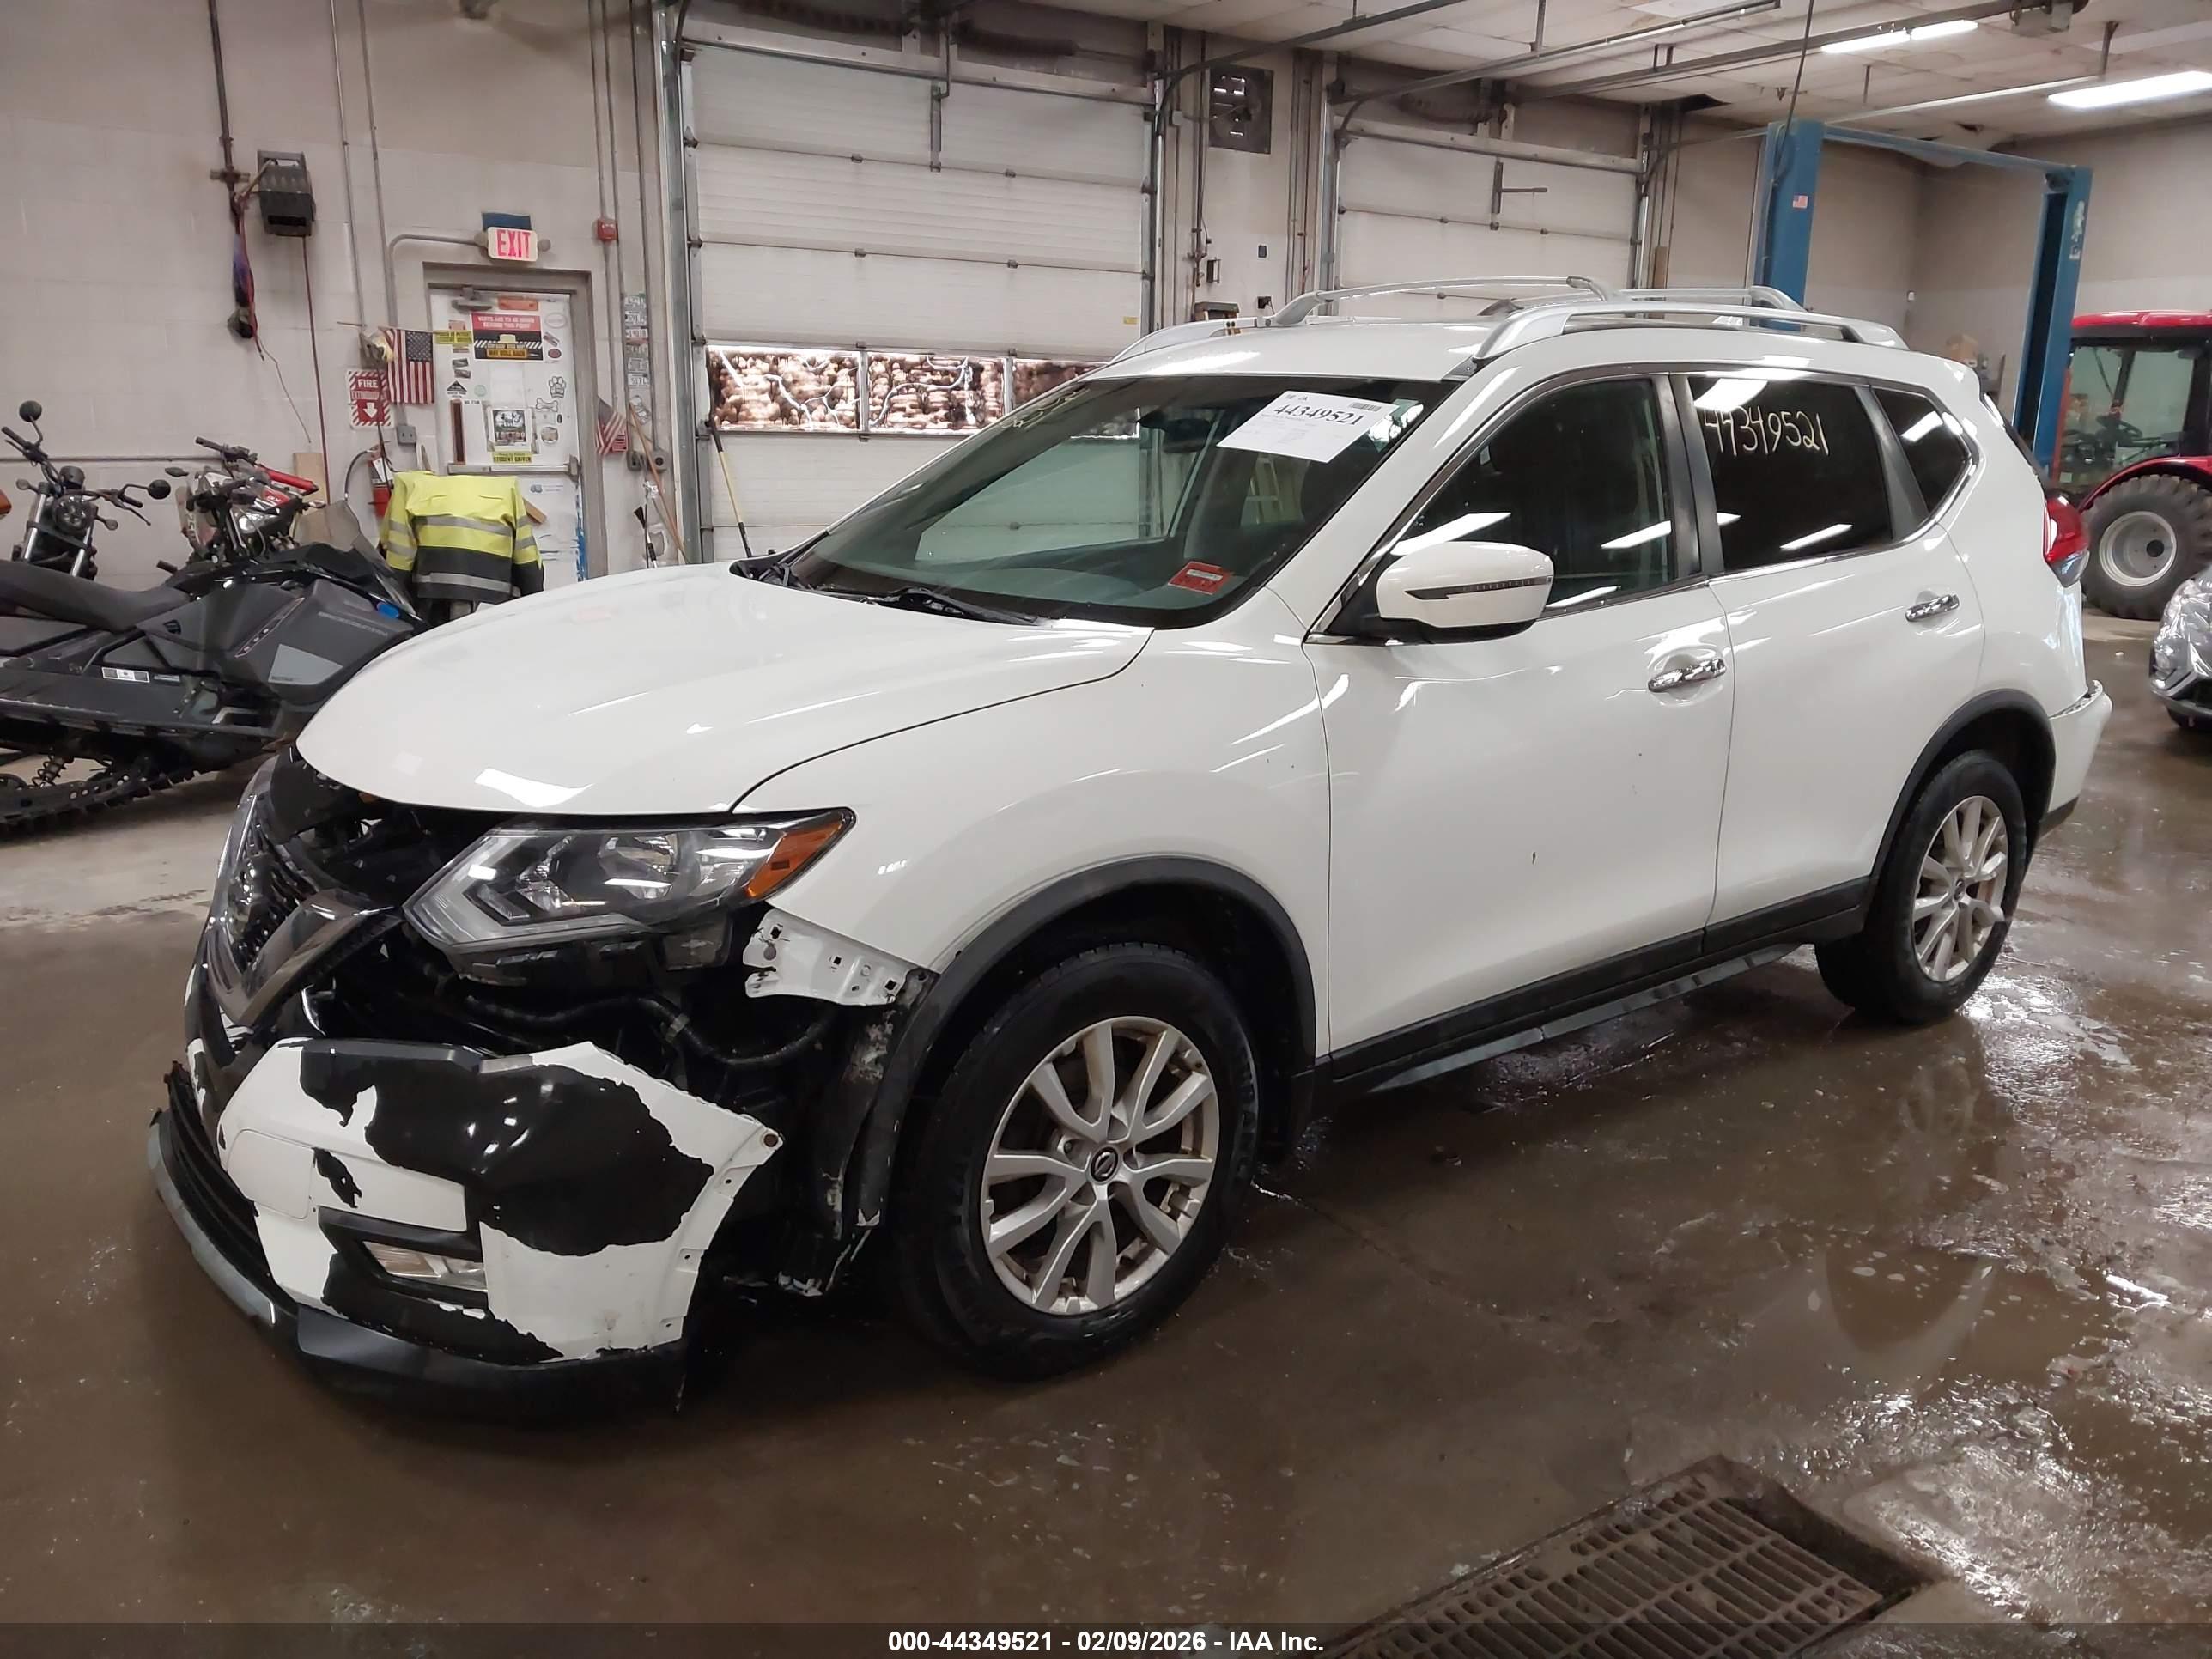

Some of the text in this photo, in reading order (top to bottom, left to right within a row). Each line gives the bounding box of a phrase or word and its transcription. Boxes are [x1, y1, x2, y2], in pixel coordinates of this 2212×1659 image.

[496, 228, 531, 258] EXIT
[357, 379, 378, 387] FIRE
[1274, 404, 1364, 425] 44349521
[1705, 406, 1831, 456] 44349521
